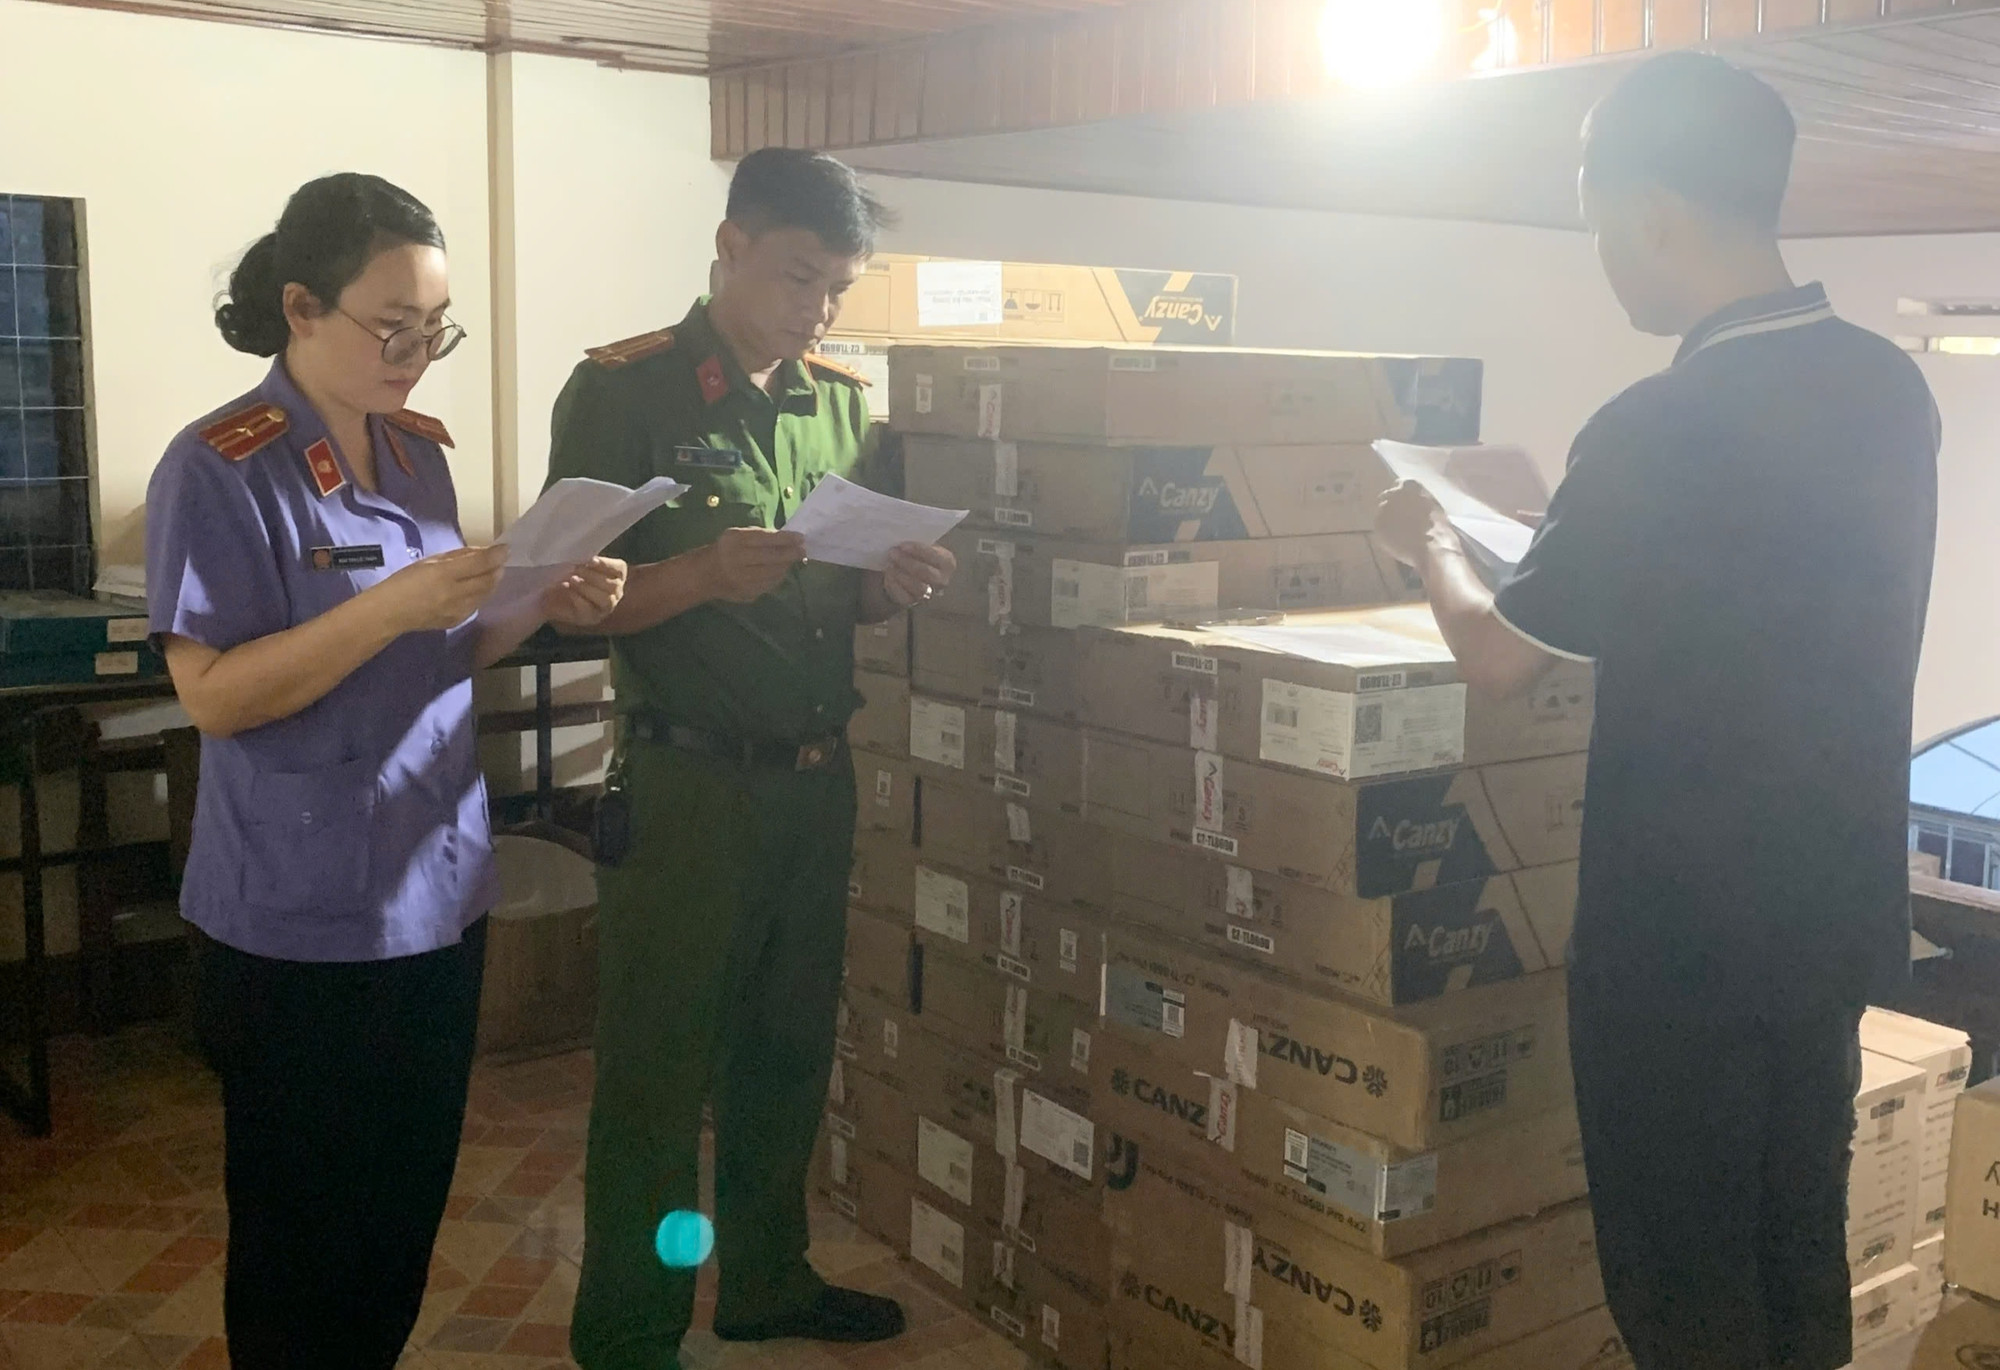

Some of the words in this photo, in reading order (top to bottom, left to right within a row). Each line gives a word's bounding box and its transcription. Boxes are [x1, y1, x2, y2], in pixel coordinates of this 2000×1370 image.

[1143, 295, 1204, 326] Canzy
[1160, 482, 1219, 513] Canzy
[1392, 817, 1461, 851] Canzy
[1428, 920, 1494, 958] Canzy
[1134, 1078, 1209, 1129] CANZ
